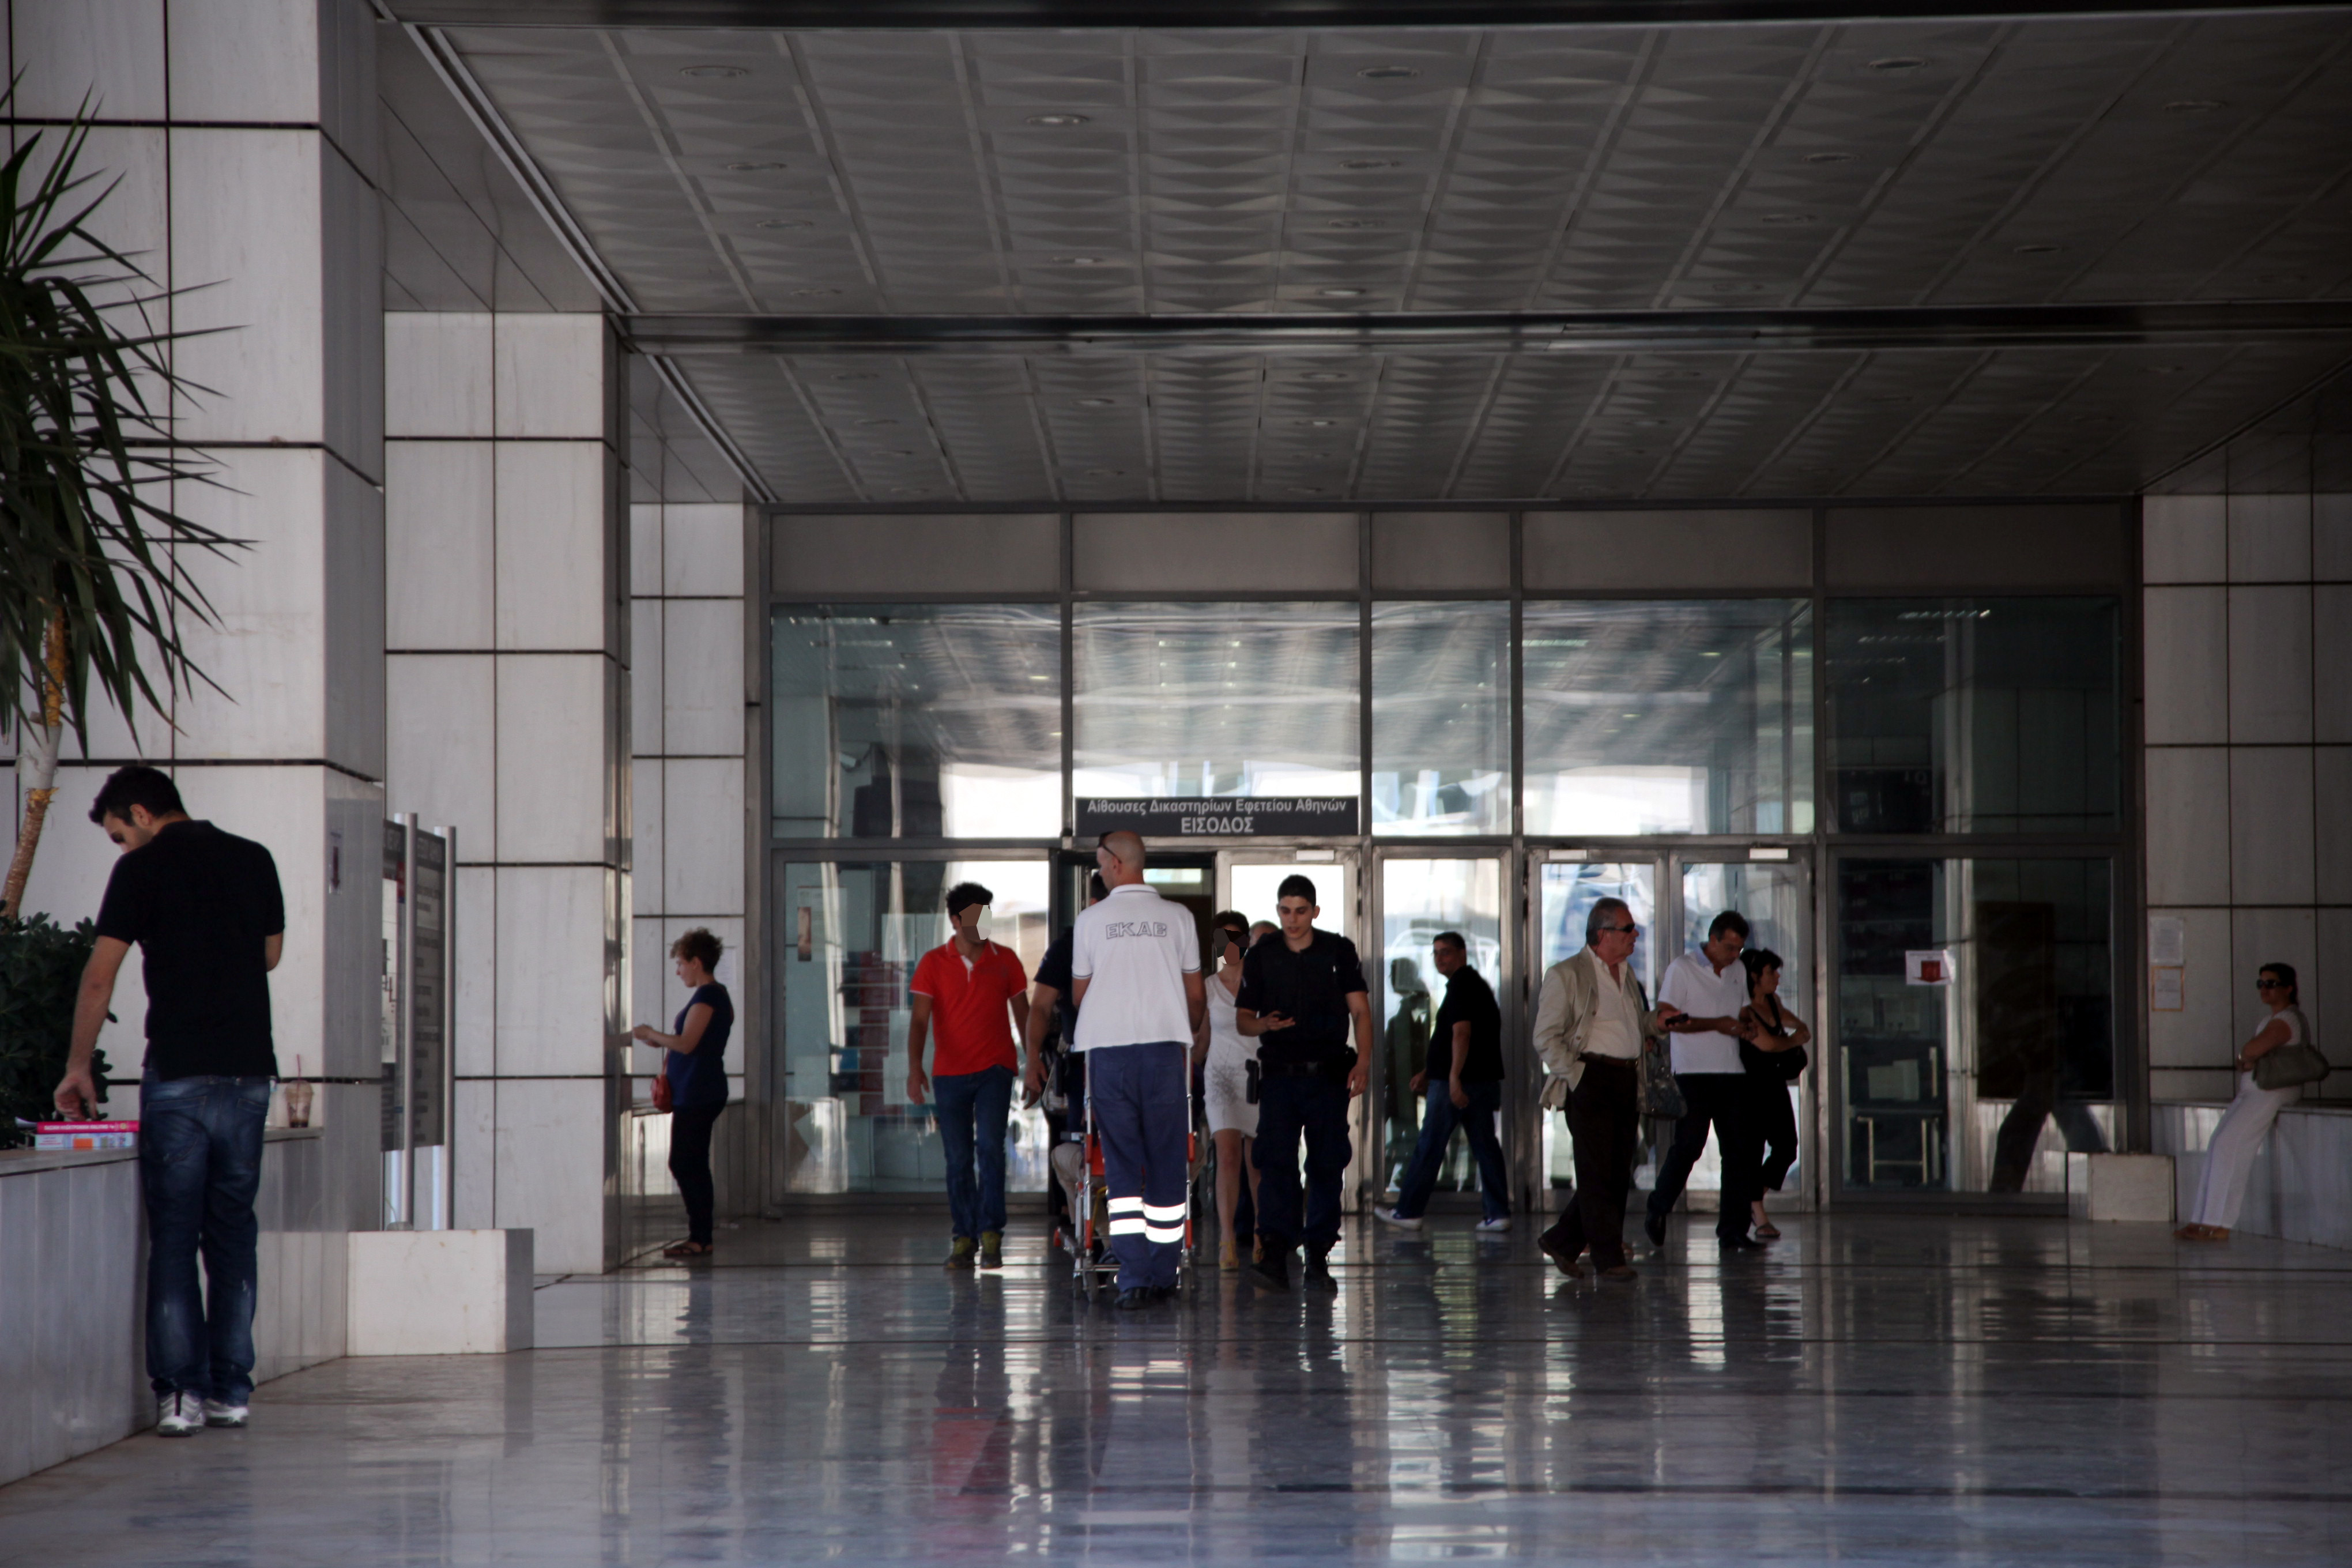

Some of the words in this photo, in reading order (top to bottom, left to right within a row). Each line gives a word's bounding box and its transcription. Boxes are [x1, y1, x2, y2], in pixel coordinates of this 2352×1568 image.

[1087, 800, 1146, 815] Αίθουσες
[1149, 799, 1231, 815] Δικαστηρίων
[1235, 798, 1292, 815] Εφετείου
[1295, 798, 1347, 815] Αθηνών
[1181, 816, 1254, 834] ΕΙΣΟΔΟΣ
[1106, 921, 1167, 940] ΕΚΑΒ
